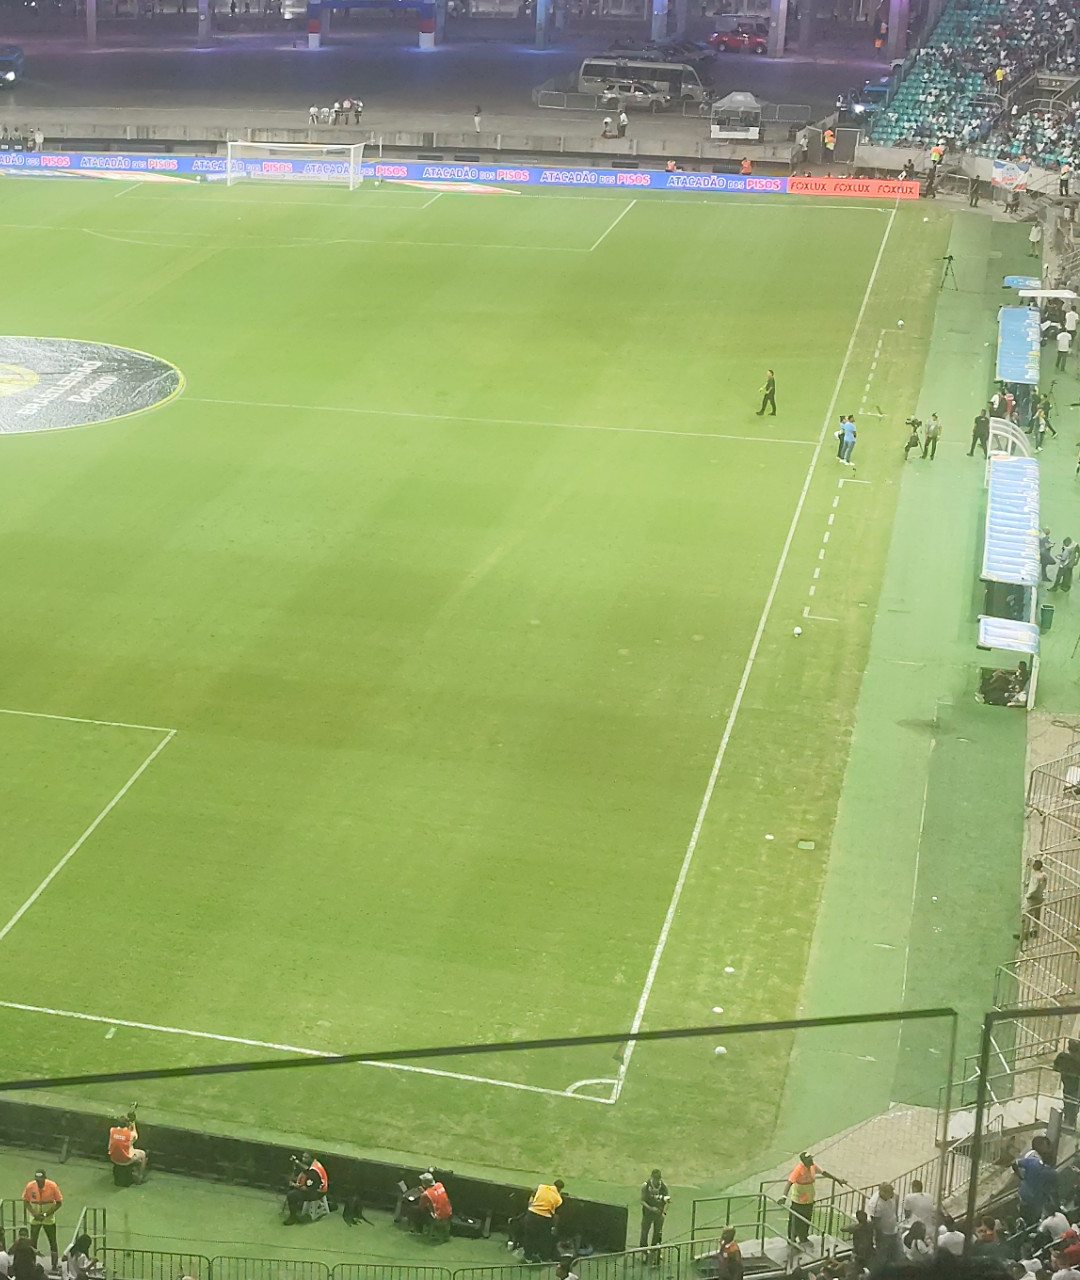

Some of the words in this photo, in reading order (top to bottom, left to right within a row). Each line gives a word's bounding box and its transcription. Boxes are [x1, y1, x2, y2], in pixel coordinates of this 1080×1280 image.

[41, 156, 70, 167] PISOS
[80, 156, 130, 169] ATACADÃO
[148, 159, 178, 170] PISOS
[262, 162, 293, 173] PISOS
[376, 165, 407, 176] PISOS
[423, 166, 479, 179] ATACADÃO
[497, 170, 530, 181] PISOS
[540, 171, 597, 184] ATACADÃO
[617, 173, 650, 185] PISOS
[667, 175, 726, 188] ATACADÃO
[746, 179, 781, 190] PISOS
[790, 181, 827, 191] FOXLUX
[833, 183, 870, 193] FOXLUX
[877, 185, 914, 195] FOXLUX
